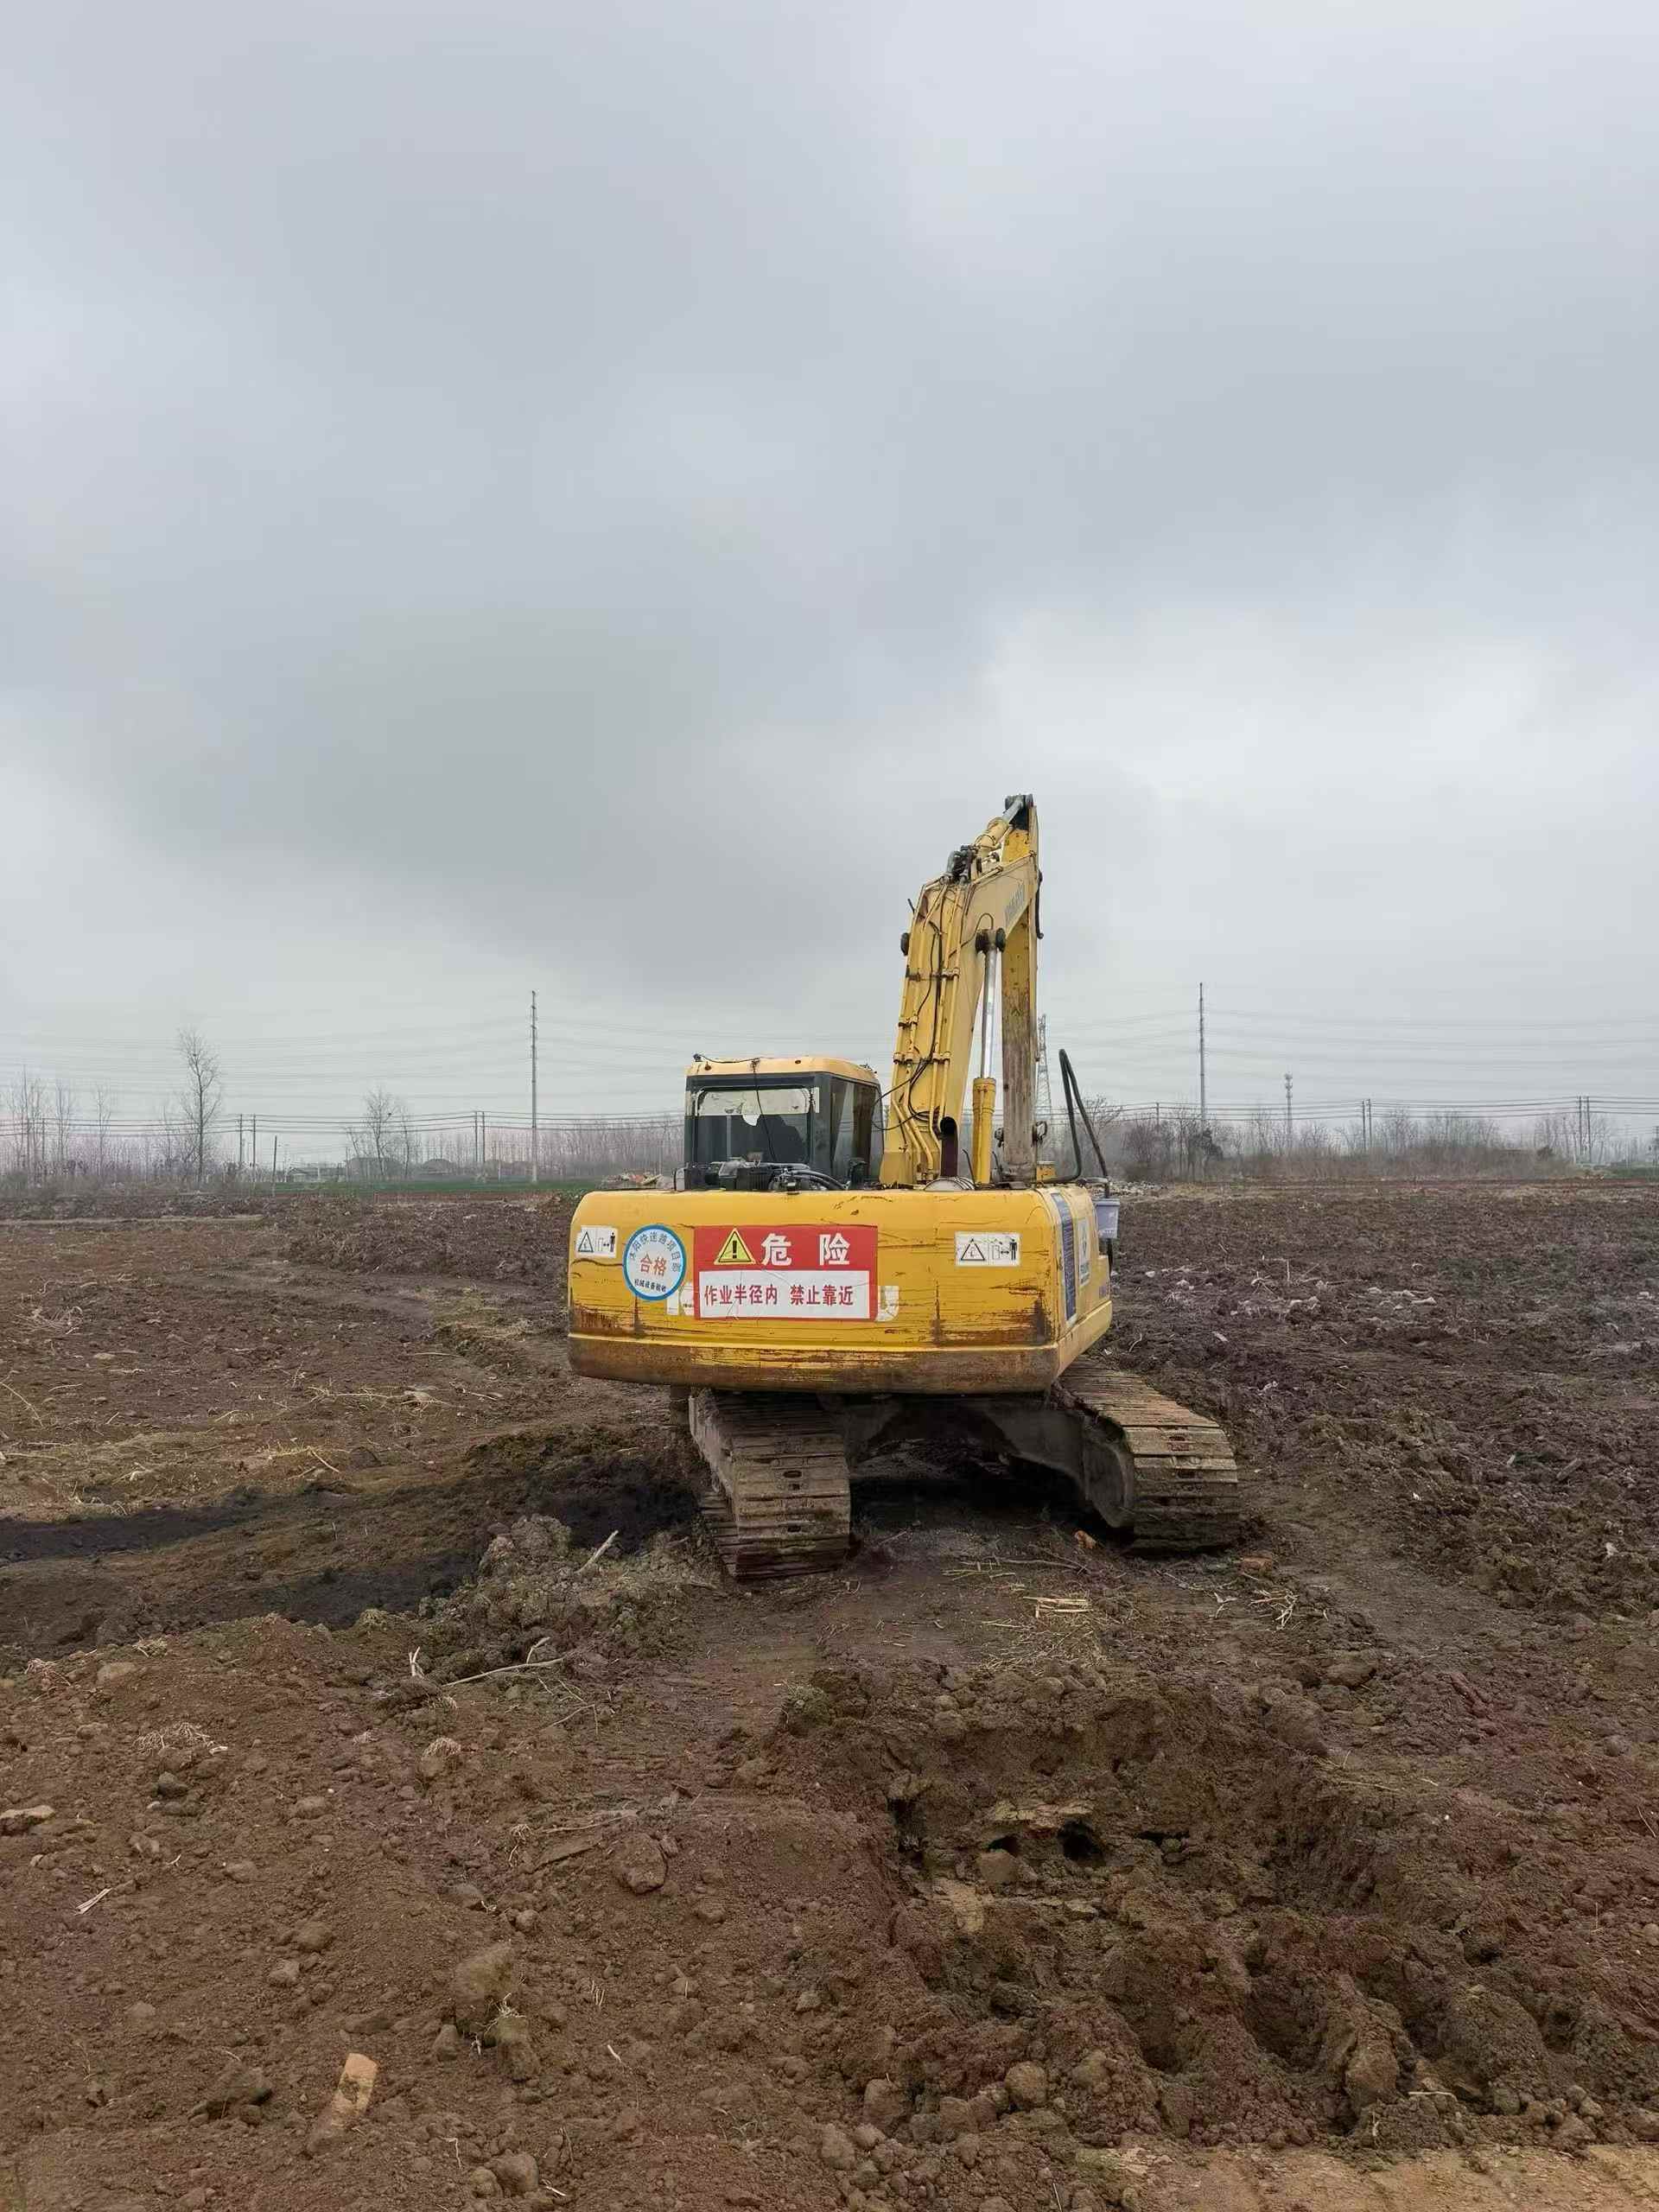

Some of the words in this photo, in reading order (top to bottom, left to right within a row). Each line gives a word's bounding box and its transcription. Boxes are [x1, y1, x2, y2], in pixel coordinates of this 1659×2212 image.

[761, 1233, 850, 1266] 危险
[640, 1252, 667, 1277] 合格
[704, 1283, 778, 1306] 作业半径内
[790, 1284, 854, 1306] 禁止靠近
